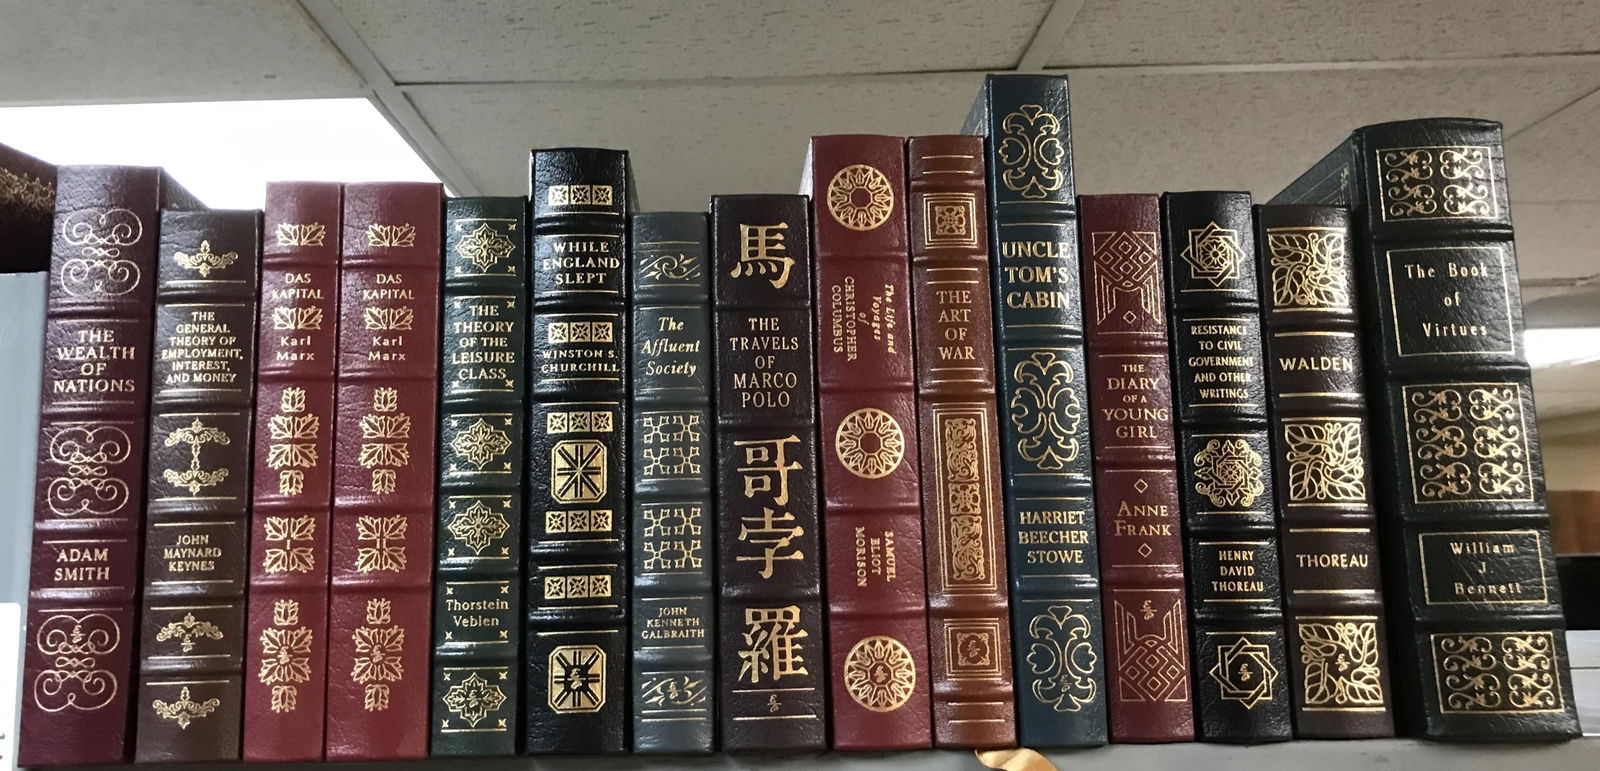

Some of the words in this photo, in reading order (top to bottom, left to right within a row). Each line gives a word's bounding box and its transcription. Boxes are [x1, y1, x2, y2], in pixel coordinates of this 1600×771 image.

[553, 241, 609, 253] WHILE
[1002, 241, 1070, 259] UNCLE
[543, 258, 621, 270] ENGLAND
[1404, 264, 1436, 279] The
[1448, 262, 1488, 278] Book
[285, 273, 311, 284] DAS
[376, 273, 402, 284] DAS
[555, 273, 607, 285] SLEPT
[1004, 266, 1069, 284] TOM'S
[272, 288, 325, 300] KAPITAL
[363, 288, 415, 300] KAPITAL
[884, 284, 895, 303] The
[936, 290, 972, 304] THE
[1444, 292, 1461, 307] of
[1006, 292, 1070, 309] CABIN
[191, 311, 215, 322] THE
[469, 304, 499, 317] THE
[938, 309, 971, 323] ART
[832, 285, 843, 353] COLUMBUS
[845, 276, 857, 362] CHRISTOPHER
[858, 312, 870, 326] of
[871, 295, 882, 341] Voyages
[885, 306, 896, 329] Life
[176, 324, 230, 334] GENERAL
[453, 321, 515, 333] THEORY
[658, 317, 684, 332] The
[748, 317, 780, 332] THE
[1190, 325, 1248, 335] RESISTANCE
[1422, 323, 1488, 337] Virtues
[78, 330, 114, 343] THE
[169, 336, 215, 346] THEORY
[219, 336, 237, 346] OF
[280, 335, 311, 346] Karl
[372, 335, 403, 346] Karl
[945, 328, 968, 341] OF
[459, 337, 477, 348] OF
[480, 336, 508, 348] THE
[642, 339, 700, 356] Affluent
[729, 336, 799, 351] TRAVELS
[887, 333, 897, 354] and
[1198, 340, 1214, 351] TO
[1217, 340, 1243, 351] CIVIL
[57, 347, 135, 360] WEALTH
[161, 349, 244, 360] EMPLOYMENT,
[276, 351, 315, 361] Marx
[368, 351, 406, 361] Marx
[452, 352, 516, 364] LEISURE
[542, 350, 604, 359] WINSTON
[608, 349, 618, 358] S.
[938, 346, 976, 360] WAR
[172, 360, 230, 372] INTEREST,
[755, 356, 775, 370] OF
[1188, 356, 1254, 367] GOVERNMENT
[1279, 357, 1353, 371] WALDEN
[80, 362, 107, 376] OF
[458, 368, 507, 380] CLASS
[541, 363, 621, 374] CHURCHILL
[646, 361, 697, 377] Society
[1122, 364, 1145, 373] THE
[165, 373, 190, 383] AND
[193, 372, 237, 383] MONEY
[734, 372, 798, 389] MARCO
[1106, 377, 1160, 391] DIARY
[1194, 372, 1216, 383] AND
[1219, 372, 1252, 383] OTHER
[53, 379, 135, 393] NATIONS
[741, 391, 790, 408] POLO
[1123, 394, 1138, 403] OF
[1140, 395, 1147, 403] A
[1199, 388, 1249, 399] WRITINGS
[1101, 409, 1169, 422] YOUNG
[1116, 426, 1158, 439] GIRL
[1020, 511, 1085, 525] HARRIET
[176, 535, 209, 546] JOHN
[1018, 530, 1089, 545] BEECHER
[163, 548, 222, 559] MAYNARD
[1450, 542, 1515, 555] William
[57, 548, 108, 563] ADAM
[855, 526, 867, 587] MORISON
[870, 538, 881, 575] ELIOT
[885, 531, 896, 582] SAMUEL
[1027, 550, 1084, 564] STOWE
[1218, 551, 1254, 562] HENRY
[1296, 554, 1368, 569] THOREAU
[168, 561, 215, 572] KEYNES
[1219, 565, 1255, 577] DAVID
[54, 567, 110, 581] SMITH
[1212, 581, 1264, 592] THOREAU
[1454, 583, 1522, 595] Bennett
[446, 599, 509, 611] Thorstein
[658, 607, 688, 616] JOHN
[453, 615, 500, 627] Veblen
[646, 618, 700, 628] KENNETH
[641, 628, 705, 639] GALBRAITH
